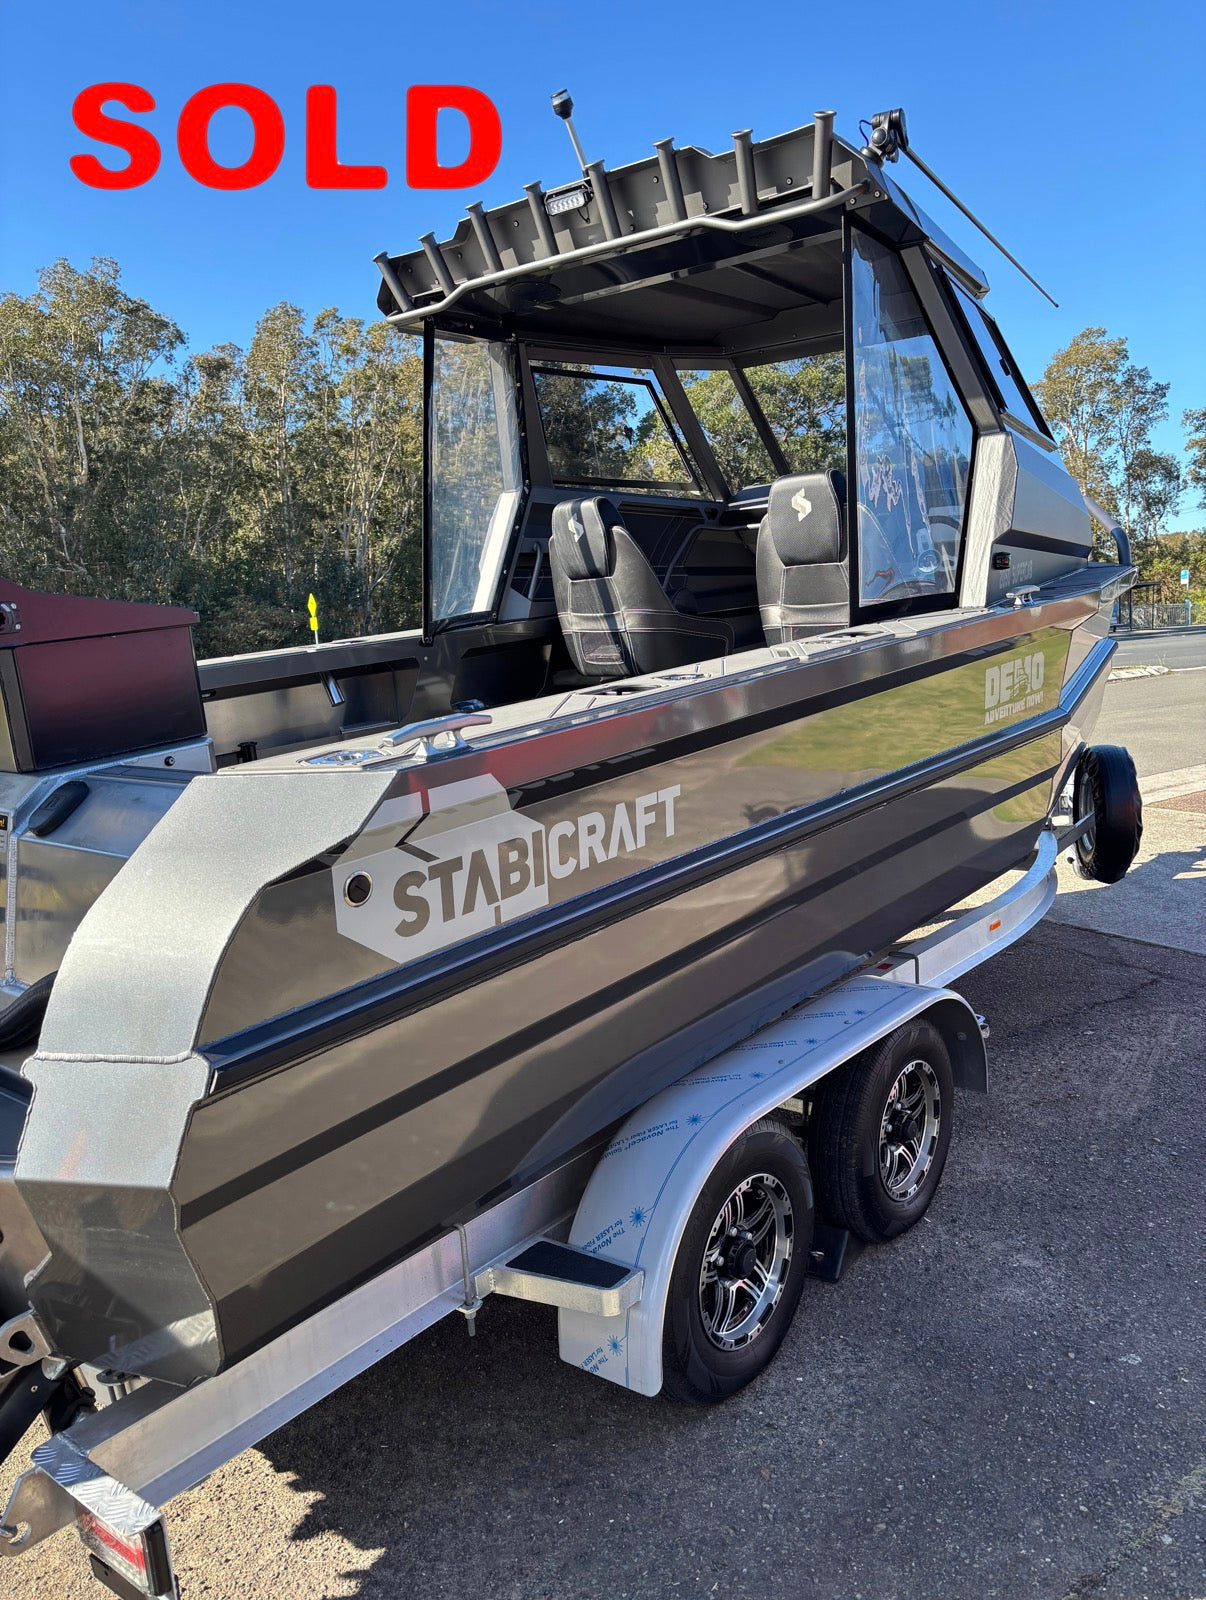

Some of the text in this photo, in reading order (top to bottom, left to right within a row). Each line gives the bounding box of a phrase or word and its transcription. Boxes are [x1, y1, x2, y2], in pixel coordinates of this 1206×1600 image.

[985, 651, 1045, 710] DEMO
[393, 784, 681, 938] STABICRAFT
[614, 1218, 623, 1228] for
[595, 1225, 614, 1241] LASER
[612, 1227, 626, 1238] The
[584, 1351, 598, 1367] LASER
[597, 1355, 608, 1365] The
